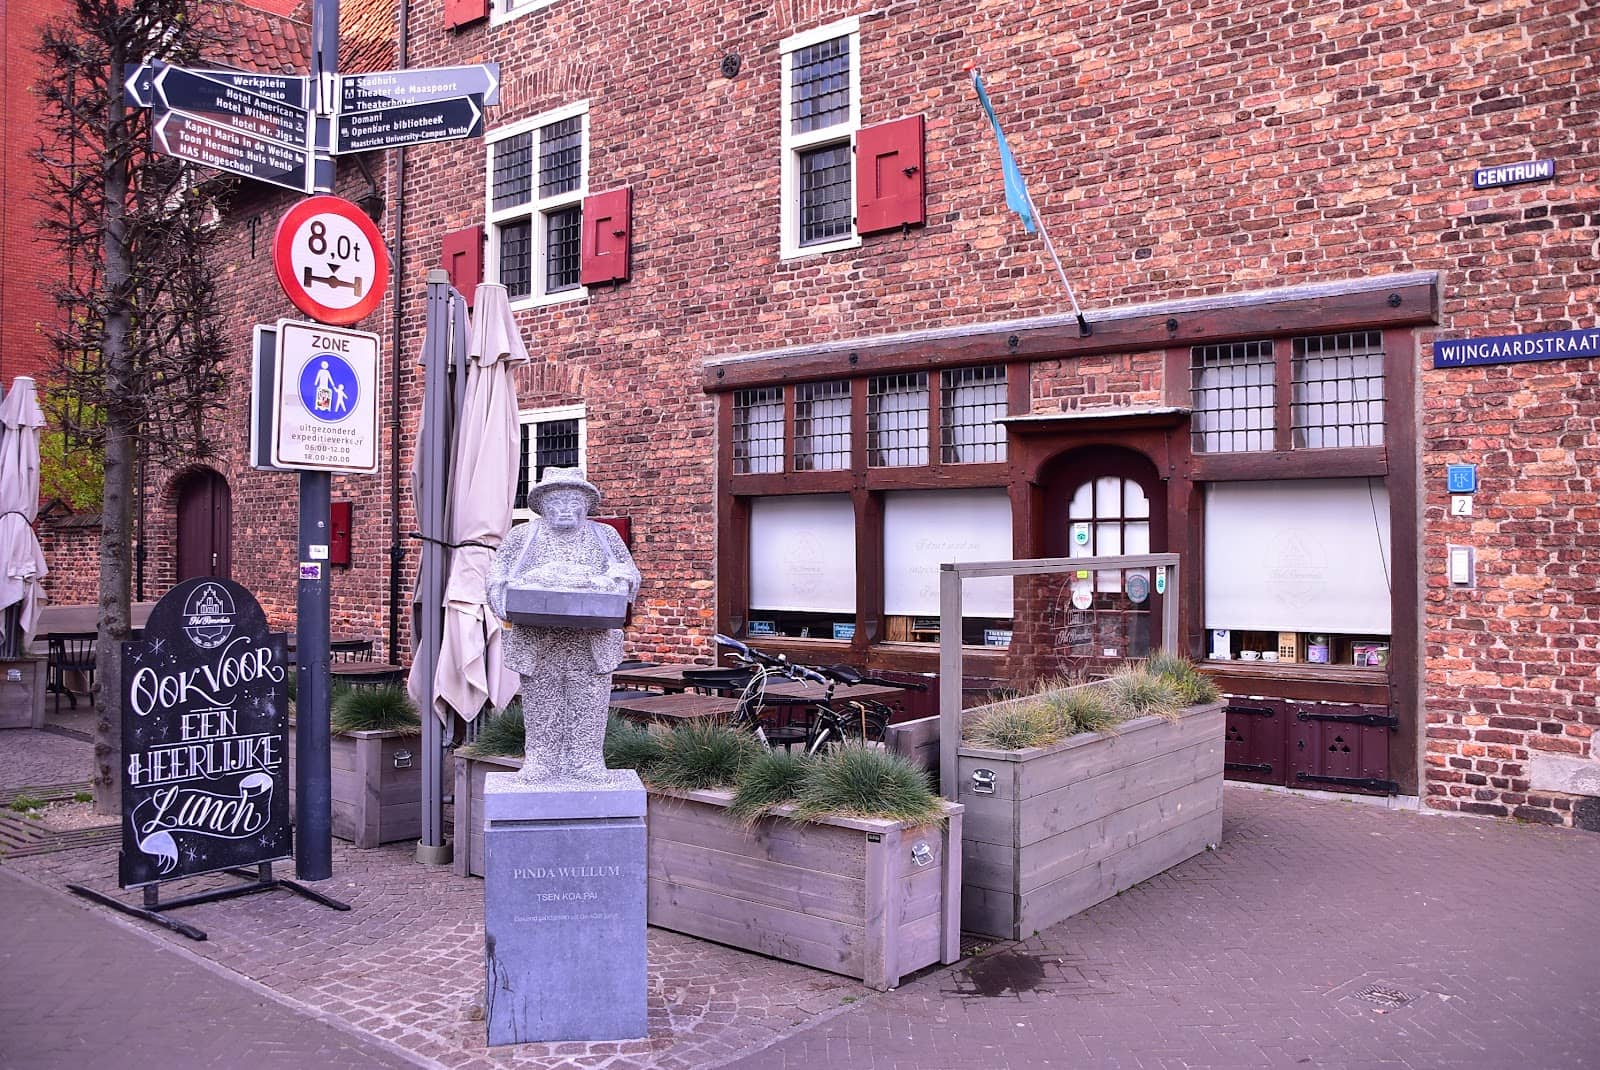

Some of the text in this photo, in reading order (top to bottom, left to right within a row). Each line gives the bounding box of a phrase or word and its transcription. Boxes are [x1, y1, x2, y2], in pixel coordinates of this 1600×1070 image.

[233, 76, 286, 90] Werkplein
[357, 77, 397, 88] Stadhuis
[357, 82, 457, 98] Theater de Maaspoort
[216, 96, 294, 130] Hotel Wilhelmina
[226, 89, 294, 119] Hotel American
[232, 116, 293, 143] Hotel Mr. Jigs
[352, 112, 383, 125] Domani
[352, 122, 391, 137] Openbare
[185, 119, 212, 136] Kapel
[215, 128, 240, 145] Maria
[255, 141, 265, 152] de
[268, 145, 293, 161] Weide
[351, 125, 468, 149] Maastricht University-Campus Venlo
[179, 130, 293, 172] Toon Hermans Huis Venlo
[179, 143, 254, 175] HAS Hogeschool
[1477, 163, 1549, 187] CENTRUM
[311, 334, 351, 353] ZONE
[1441, 334, 1600, 365] WIJNGAARDSTRAAT
[299, 423, 356, 437] uitgezonderd
[1458, 499, 1466, 513] 2
[131, 636, 285, 717] OOK VOOR
[181, 711, 238, 742] EEN
[128, 735, 283, 786] HEERLIJKE
[143, 785, 261, 834] Lunch
[514, 865, 619, 879] PINDA WULLUM
[536, 892, 560, 903] TSEN
[583, 892, 597, 901] PAI
